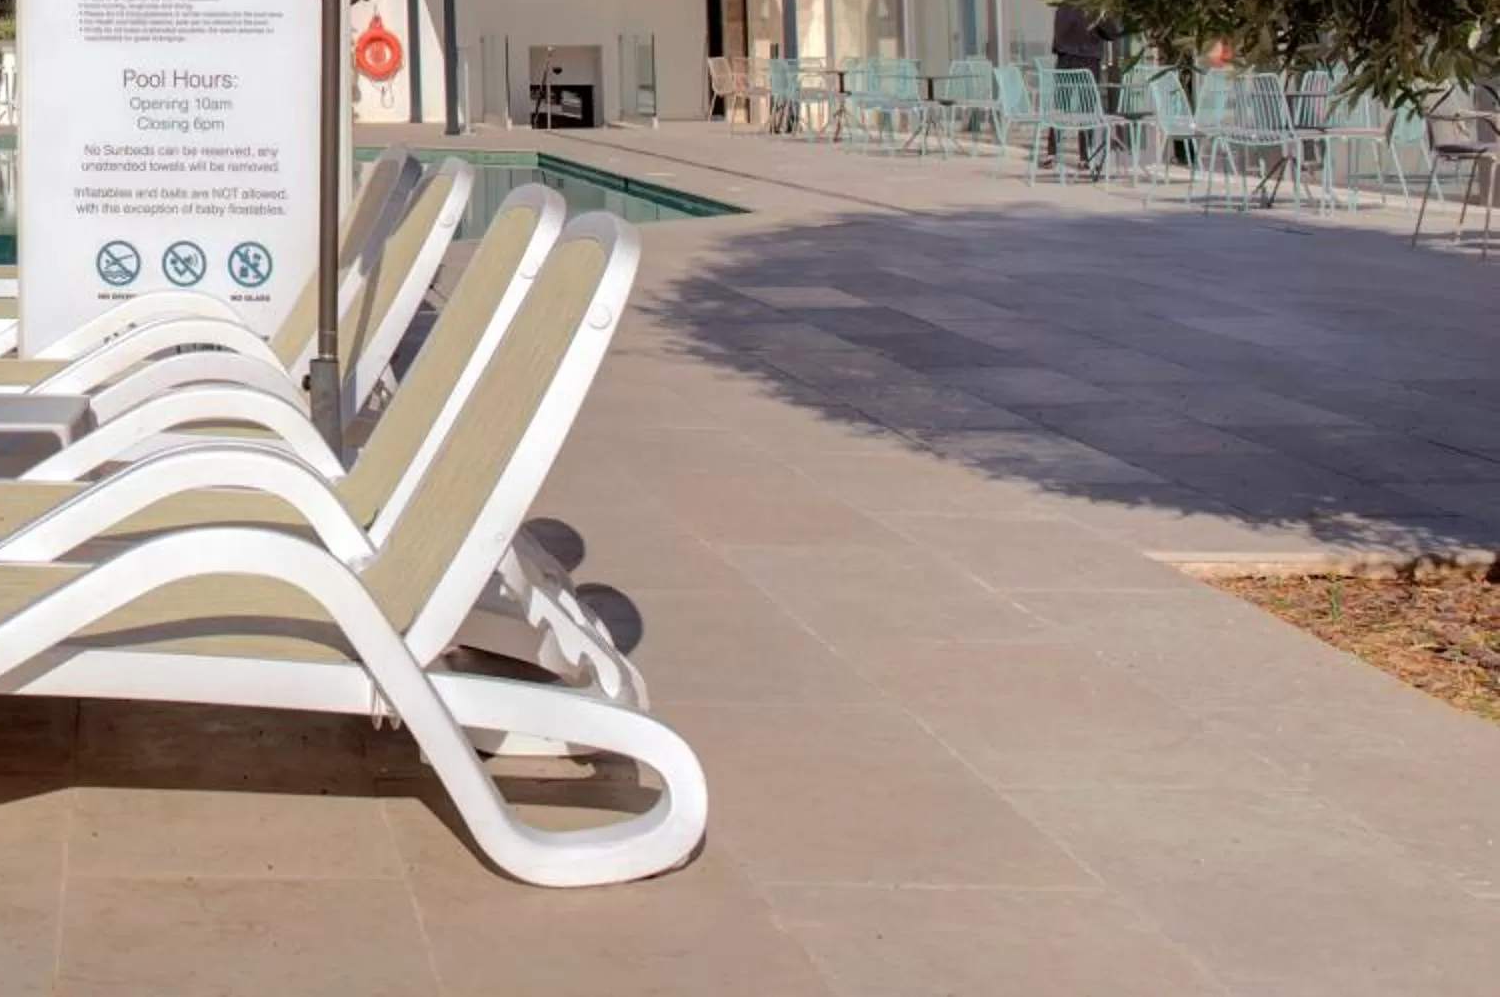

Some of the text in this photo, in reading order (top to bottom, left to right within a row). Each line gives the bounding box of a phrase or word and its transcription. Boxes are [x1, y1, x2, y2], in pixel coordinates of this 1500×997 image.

[123, 68, 238, 89] Pool Hours:
[129, 96, 233, 113] Opening 10am
[137, 116, 225, 133] Closing 6pm
[84, 145, 101, 156] No
[103, 144, 154, 156] Sunbeds
[157, 146, 179, 156] can
[182, 145, 198, 156] be
[257, 147, 279, 159] any
[81, 160, 147, 172] unattended
[149, 161, 186, 172] towels
[188, 161, 207, 172] will
[209, 160, 225, 172] be
[74, 187, 132, 199] Inflatables
[135, 187, 157, 199] and
[191, 190, 209, 199] are
[212, 187, 238, 199] NOT
[76, 203, 99, 214] with
[102, 203, 120, 214] the
[123, 203, 179, 217] exception
[181, 203, 193, 214] of
[195, 203, 226, 217] baby
